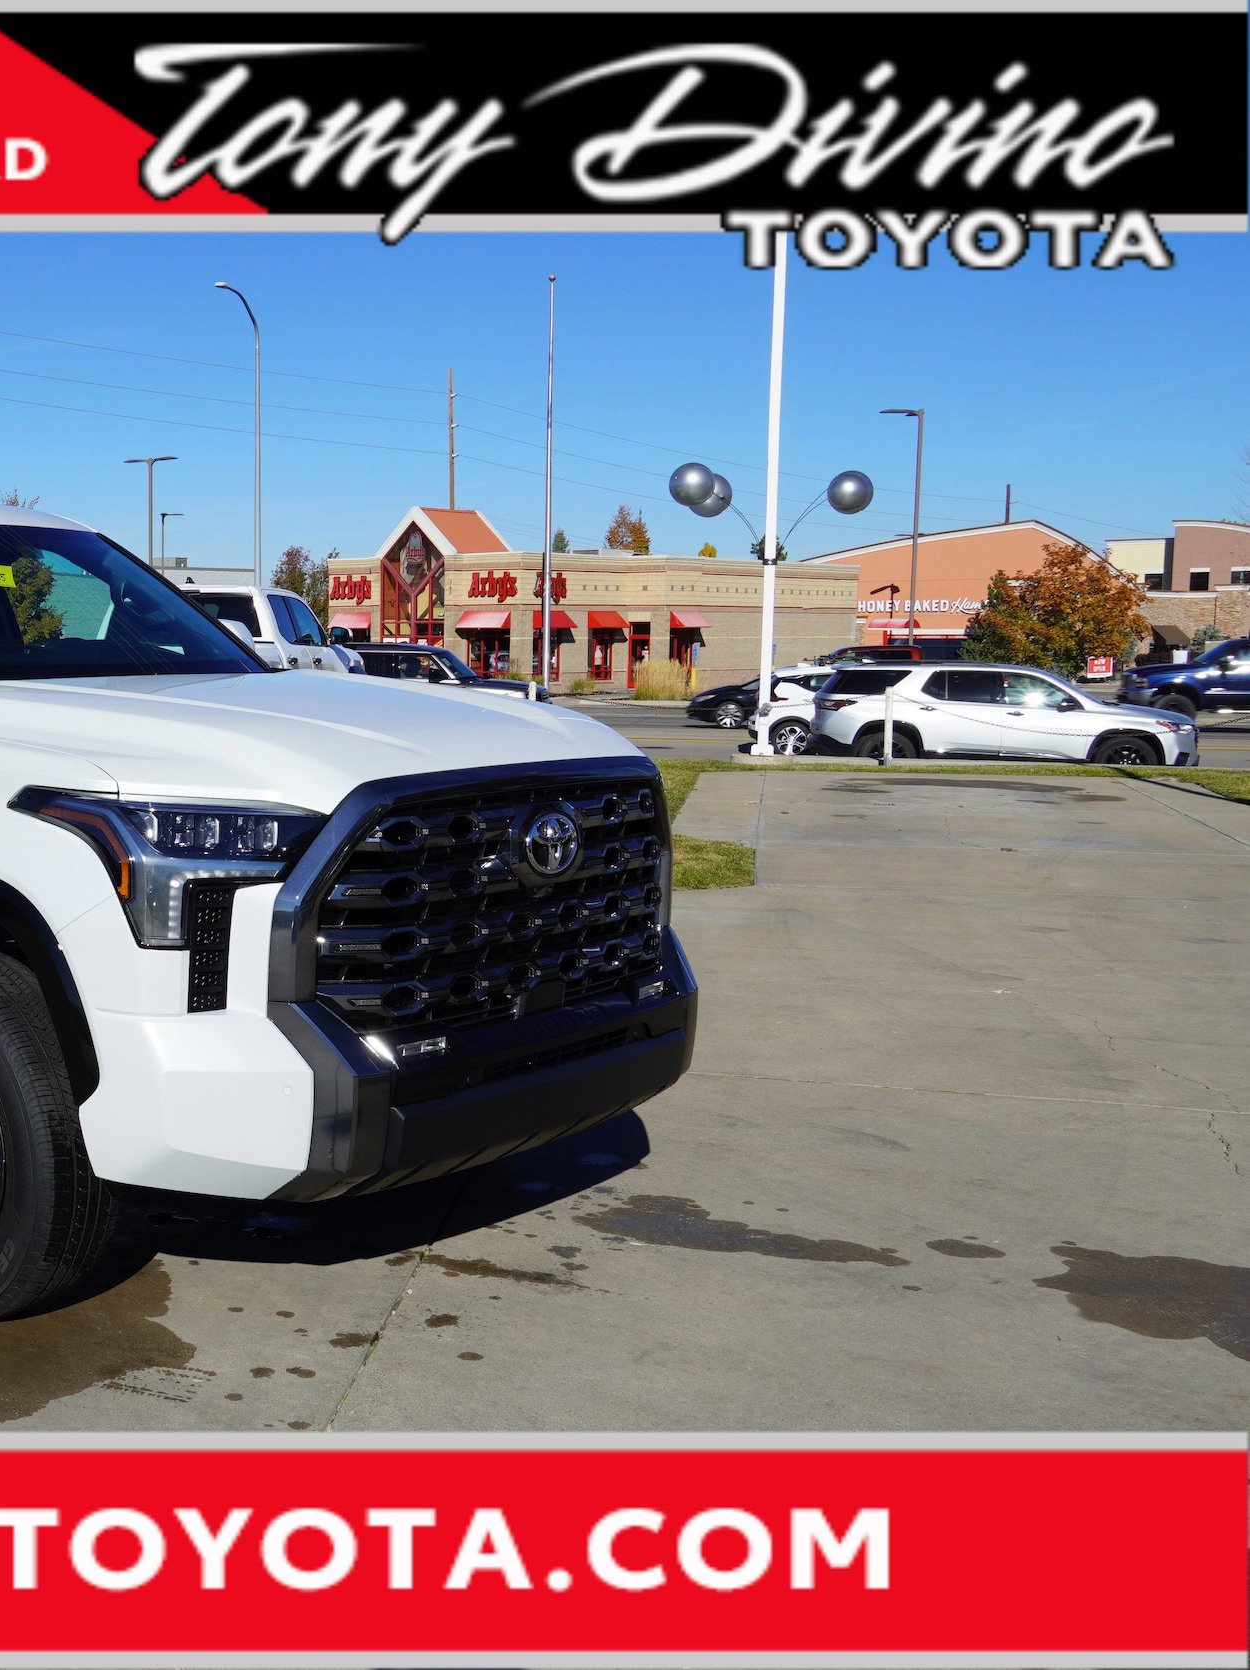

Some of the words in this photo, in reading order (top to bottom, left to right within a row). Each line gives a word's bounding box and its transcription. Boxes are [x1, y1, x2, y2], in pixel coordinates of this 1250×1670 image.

[330, 575, 372, 605] Arby's
[468, 570, 518, 603] Arby's
[857, 600, 902, 613] HONEY
[904, 600, 950, 613] BAKED
